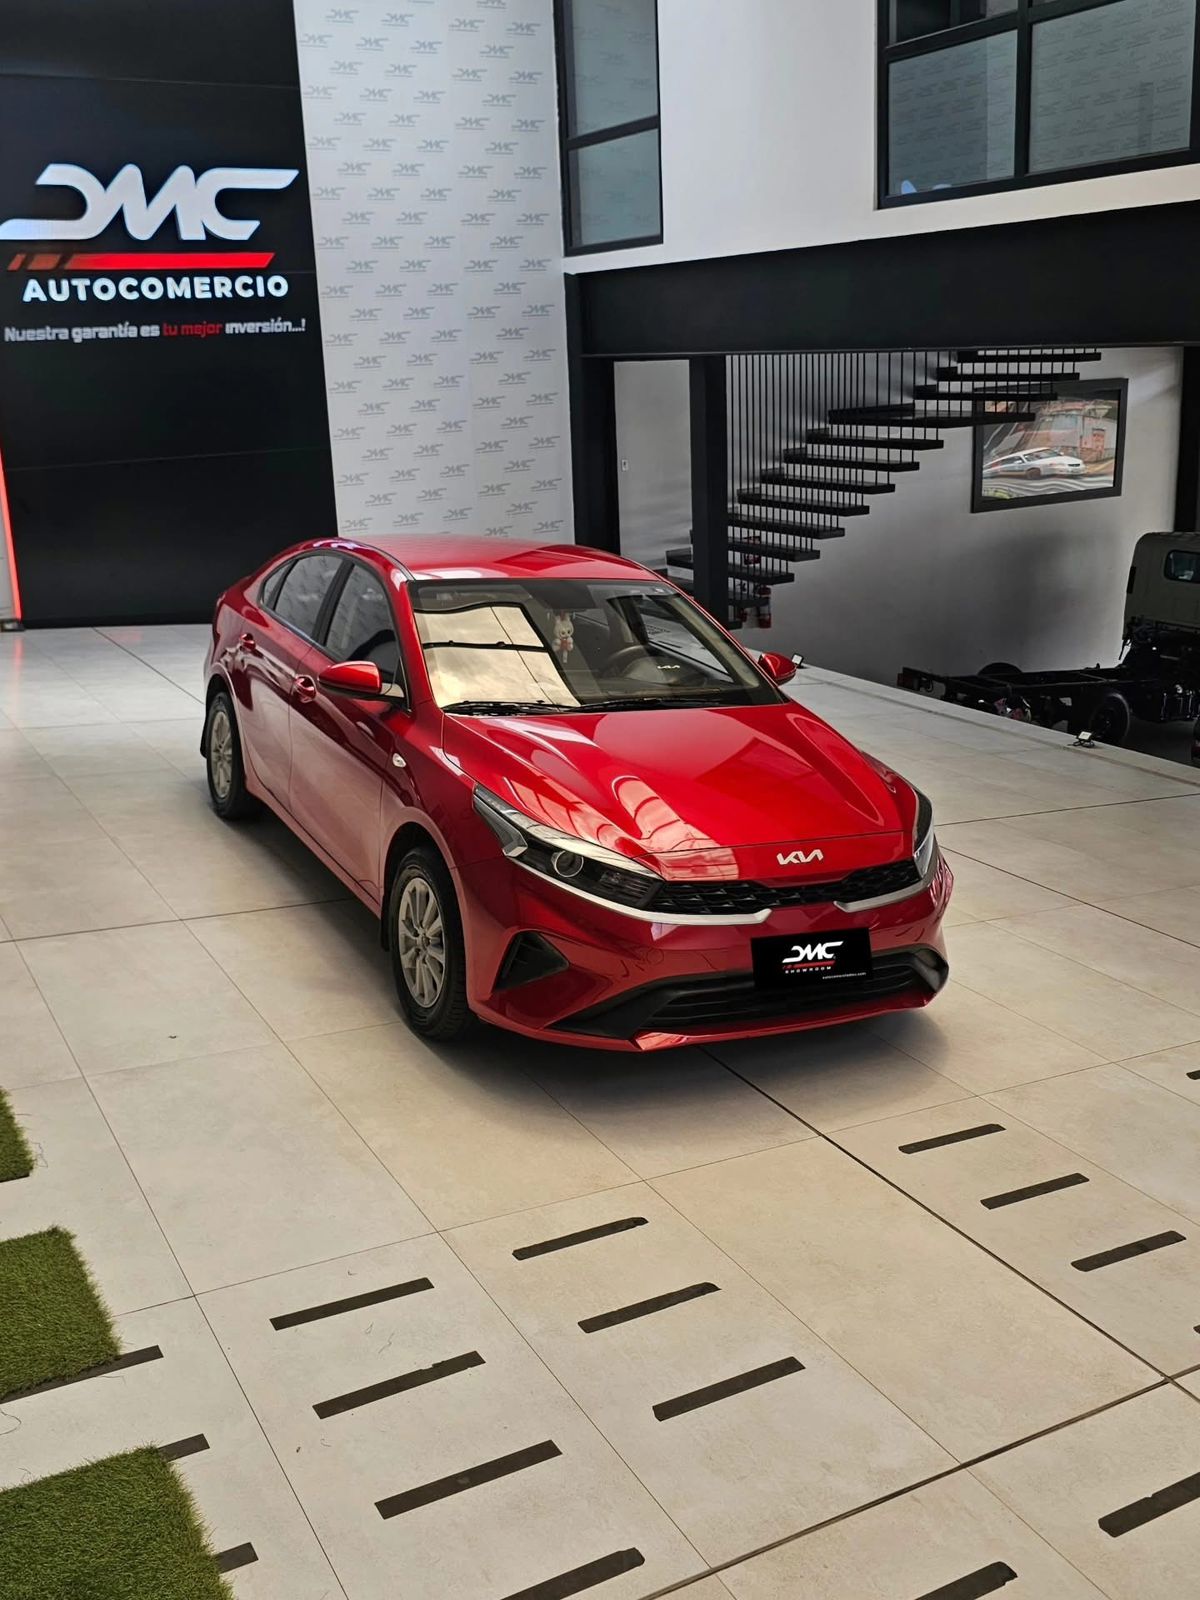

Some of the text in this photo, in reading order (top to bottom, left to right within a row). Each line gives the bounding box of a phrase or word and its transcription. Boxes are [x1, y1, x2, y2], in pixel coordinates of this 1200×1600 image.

[0, 163, 300, 241] DMC
[22, 275, 289, 302] AUTOCOMERCIO
[4, 325, 70, 342] Nuestra
[71, 321, 138, 343] garantía
[140, 324, 160, 337] es
[163, 322, 178, 336] tu
[180, 321, 223, 338] mejor
[776, 849, 824, 865] KIA
[782, 940, 844, 963] DMC
